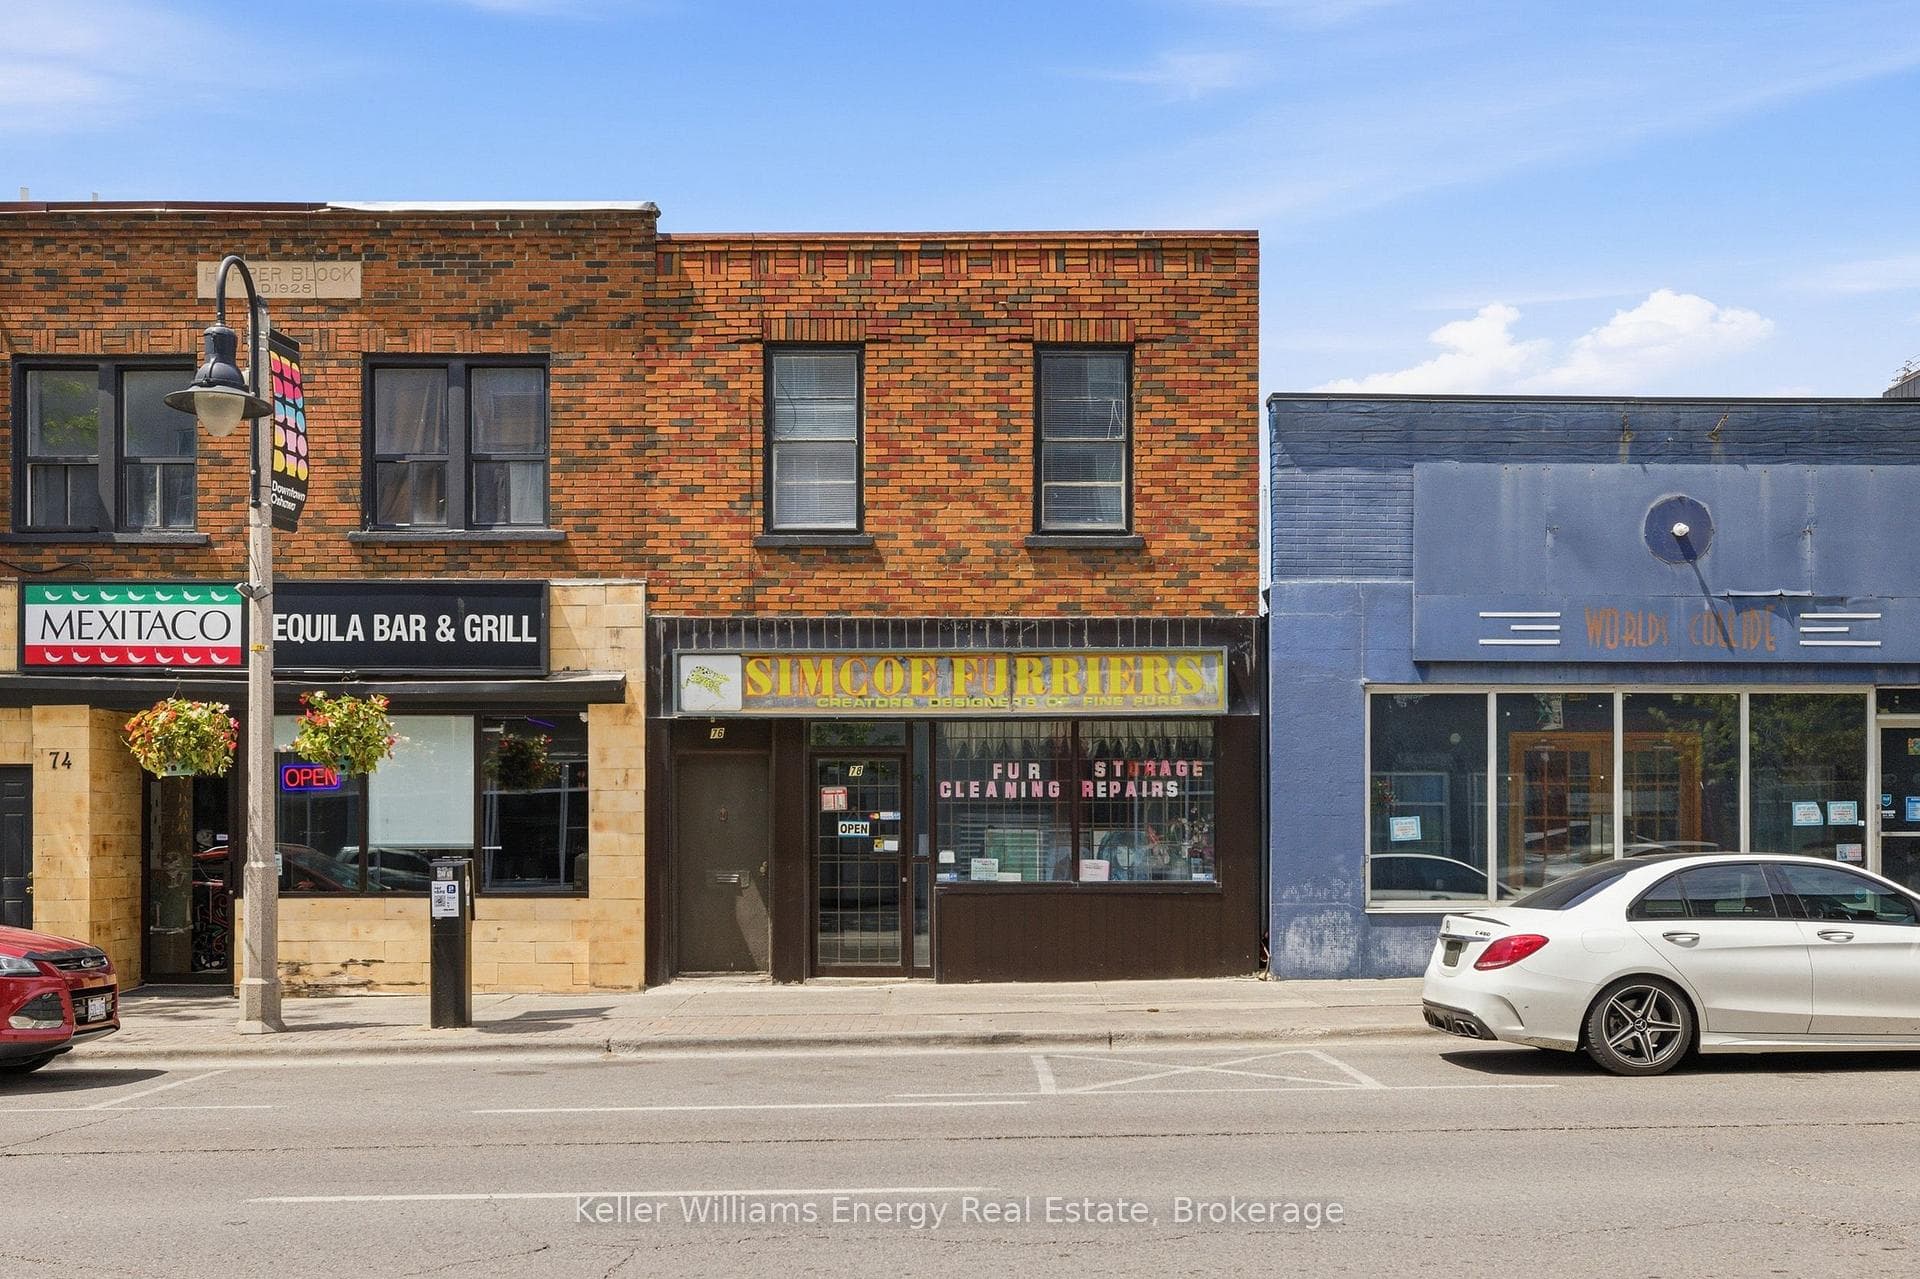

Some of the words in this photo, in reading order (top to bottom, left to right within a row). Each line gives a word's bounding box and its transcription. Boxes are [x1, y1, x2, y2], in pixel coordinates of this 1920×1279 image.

[291, 266, 355, 282] BLOCK
[40, 609, 232, 641] MEXITACO
[272, 613, 364, 644] EQUILA
[373, 614, 427, 642] BAR
[435, 614, 456, 642] &
[464, 614, 537, 643] GRILL
[745, 656, 937, 697] SIMCOE
[953, 655, 1203, 696] FURRIERS
[1046, 697, 1070, 707] OF
[1084, 696, 1124, 706] FINE
[1134, 696, 1183, 706] FURS
[711, 728, 724, 739] 76
[49, 751, 72, 769] 74
[285, 768, 338, 787] OPEN
[849, 766, 863, 776] 78
[993, 763, 1041, 779] FUR
[1094, 760, 1203, 777] STORAGE
[940, 781, 1060, 798] CLEANING
[1082, 780, 1178, 797] REPAIRS
[840, 824, 868, 834] OPEN
